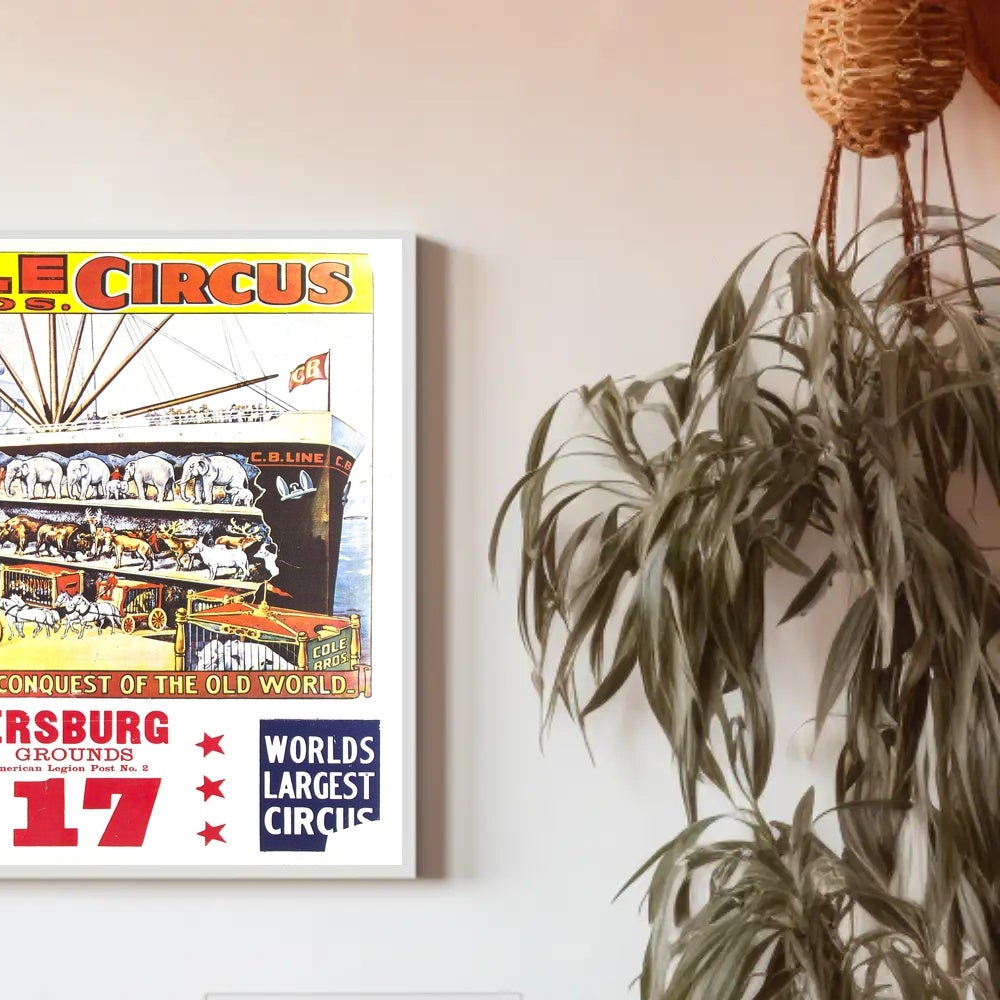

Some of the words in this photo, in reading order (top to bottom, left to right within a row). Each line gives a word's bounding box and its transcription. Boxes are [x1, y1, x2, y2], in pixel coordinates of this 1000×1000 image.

[75, 256, 354, 311] CIRCUS
[312, 638, 348, 659] COLE
[313, 651, 350, 671] BROS.
[119, 674, 148, 694] OF
[154, 674, 198, 694] THE
[205, 674, 252, 695] OLD
[15, 748, 134, 762] GROUNDS
[265, 736, 375, 765] WORLDS
[48, 765, 86, 774] Legion
[264, 771, 375, 800] LARGEST
[13, 778, 162, 847] 17
